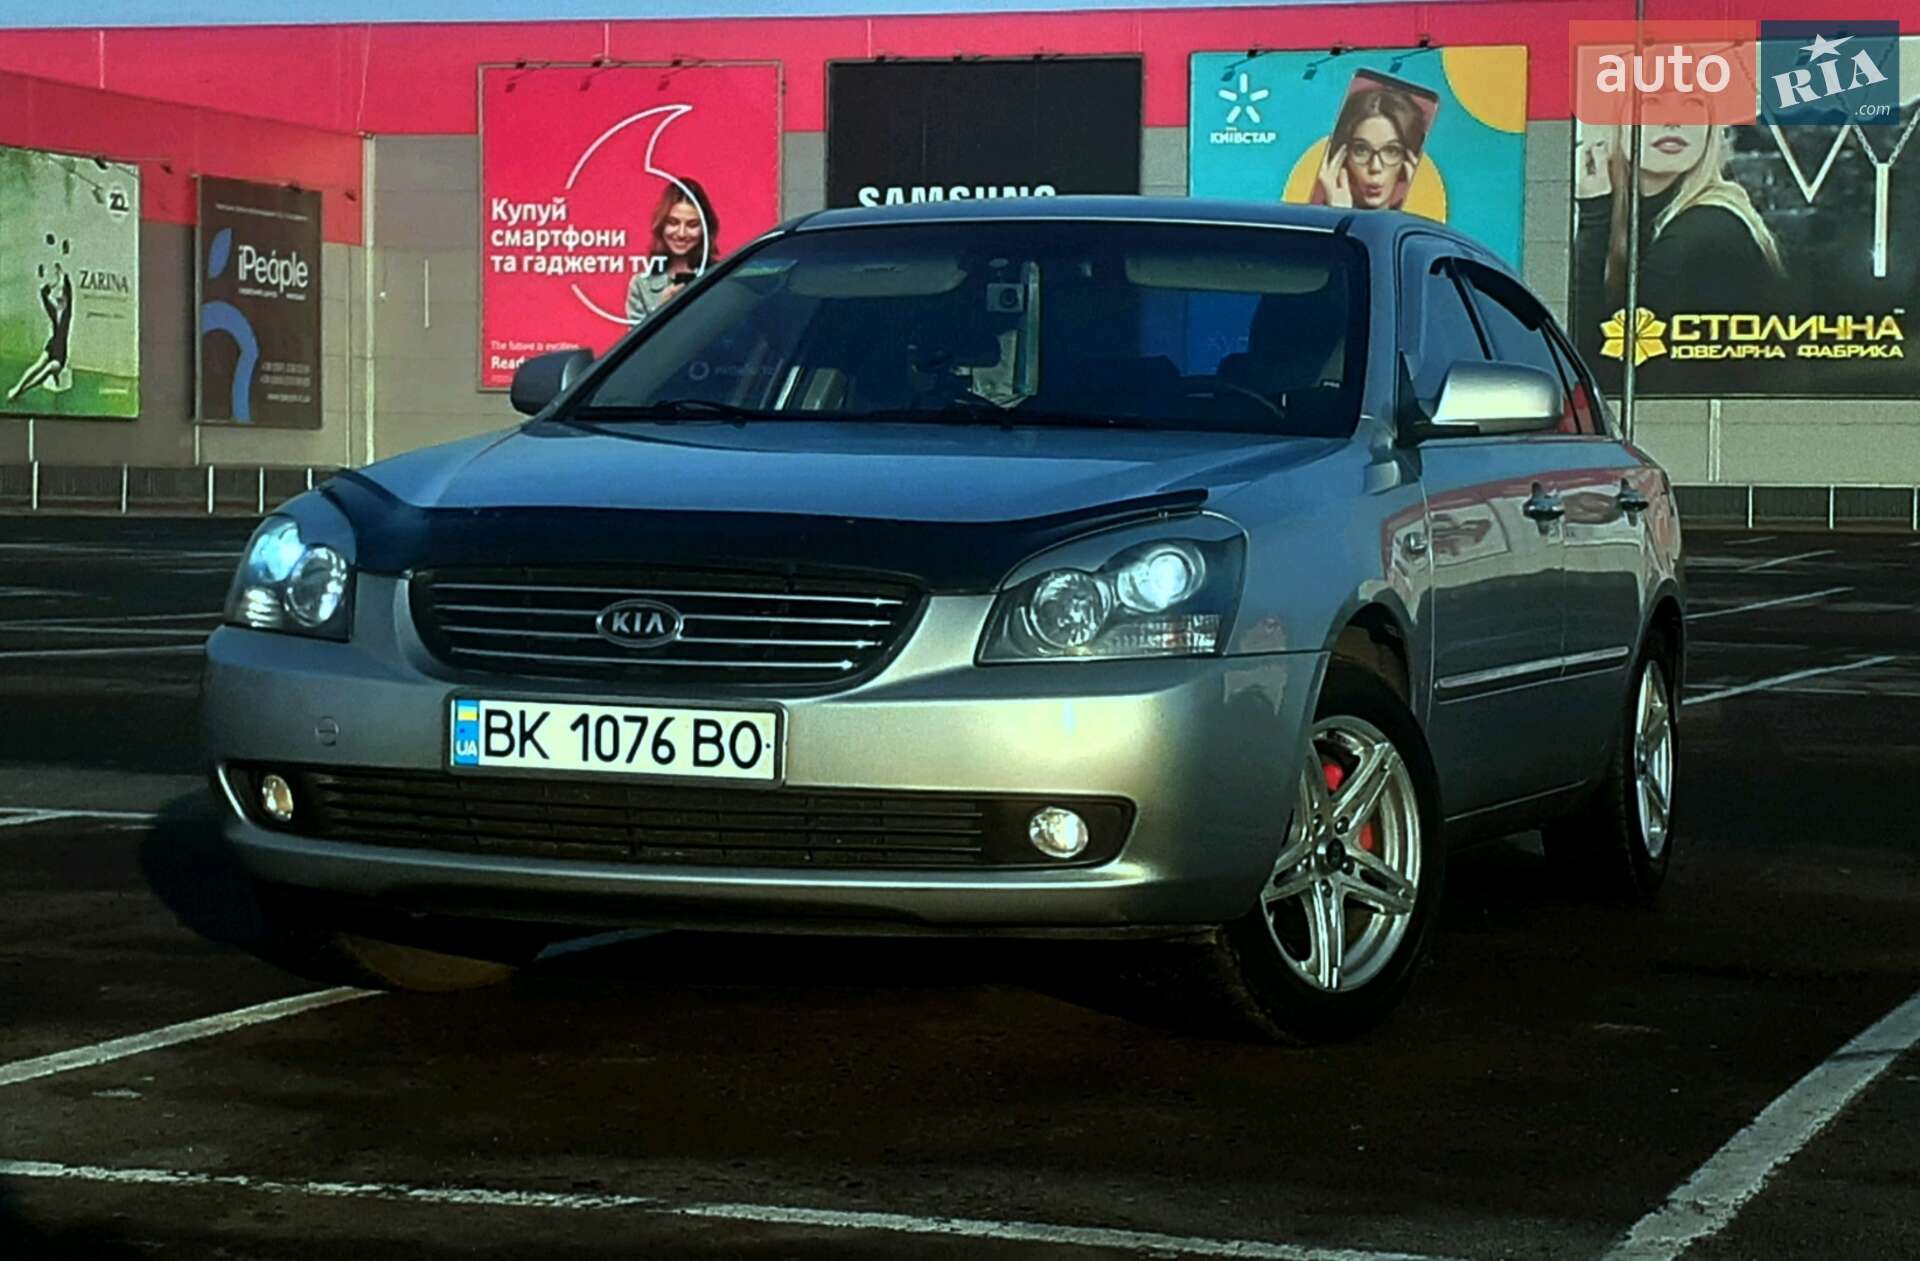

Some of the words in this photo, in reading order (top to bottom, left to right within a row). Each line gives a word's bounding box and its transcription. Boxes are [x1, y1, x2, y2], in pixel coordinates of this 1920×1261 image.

[491, 197, 567, 223] Купуй
[491, 226, 626, 251] смартфони
[491, 254, 515, 273] та
[523, 254, 623, 276] гаджети
[629, 254, 668, 278] тут
[79, 270, 129, 293] ZARINA
[1671, 315, 1904, 340] СТОЛИЧНА
[1797, 345, 1904, 358] ФАБРИКА
[611, 611, 665, 634] KIA
[456, 740, 478, 756] UA
[485, 709, 550, 759] BK
[570, 713, 676, 765] 1076
[693, 718, 762, 769] BO
